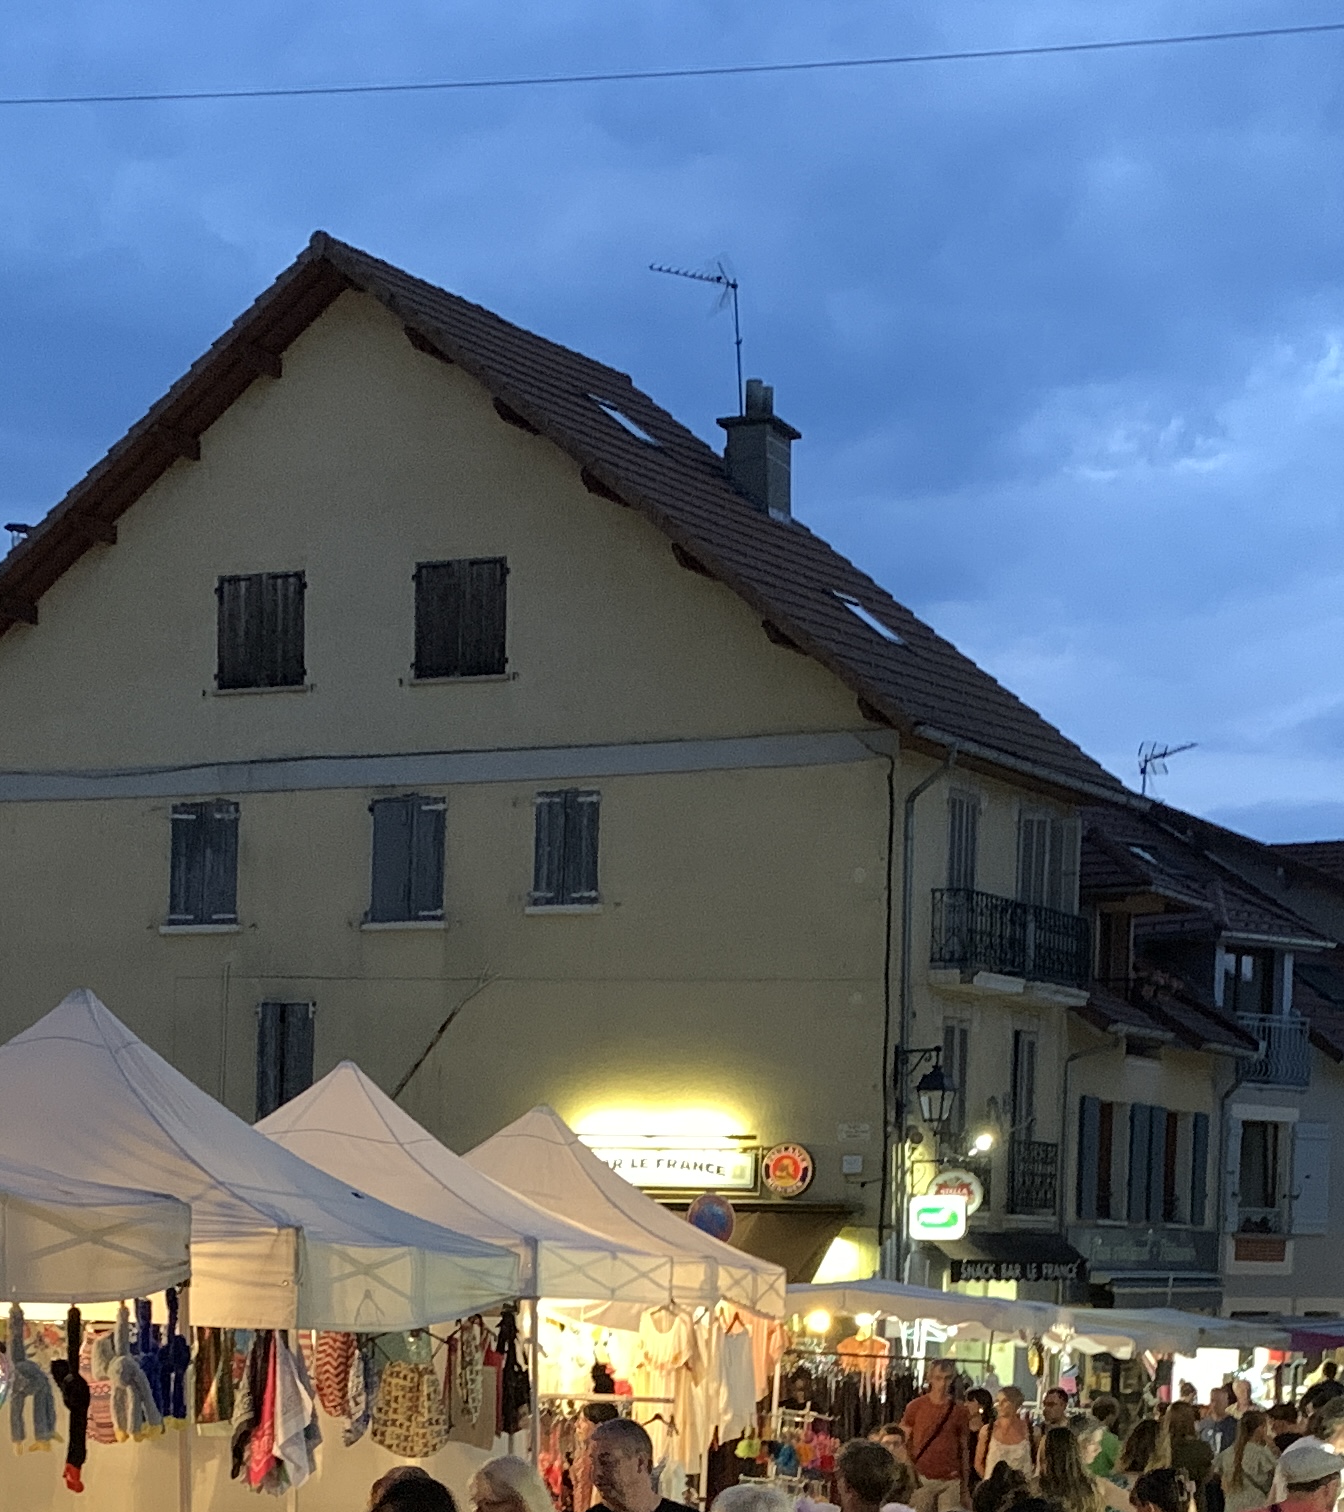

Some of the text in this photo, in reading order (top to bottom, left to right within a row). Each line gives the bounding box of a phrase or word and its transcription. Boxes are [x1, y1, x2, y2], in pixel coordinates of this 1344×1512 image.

[631, 1158, 648, 1168] LE
[656, 1158, 725, 1176] FRANCE
[960, 1260, 1079, 1280] SNACK BAR LE FRANCE
